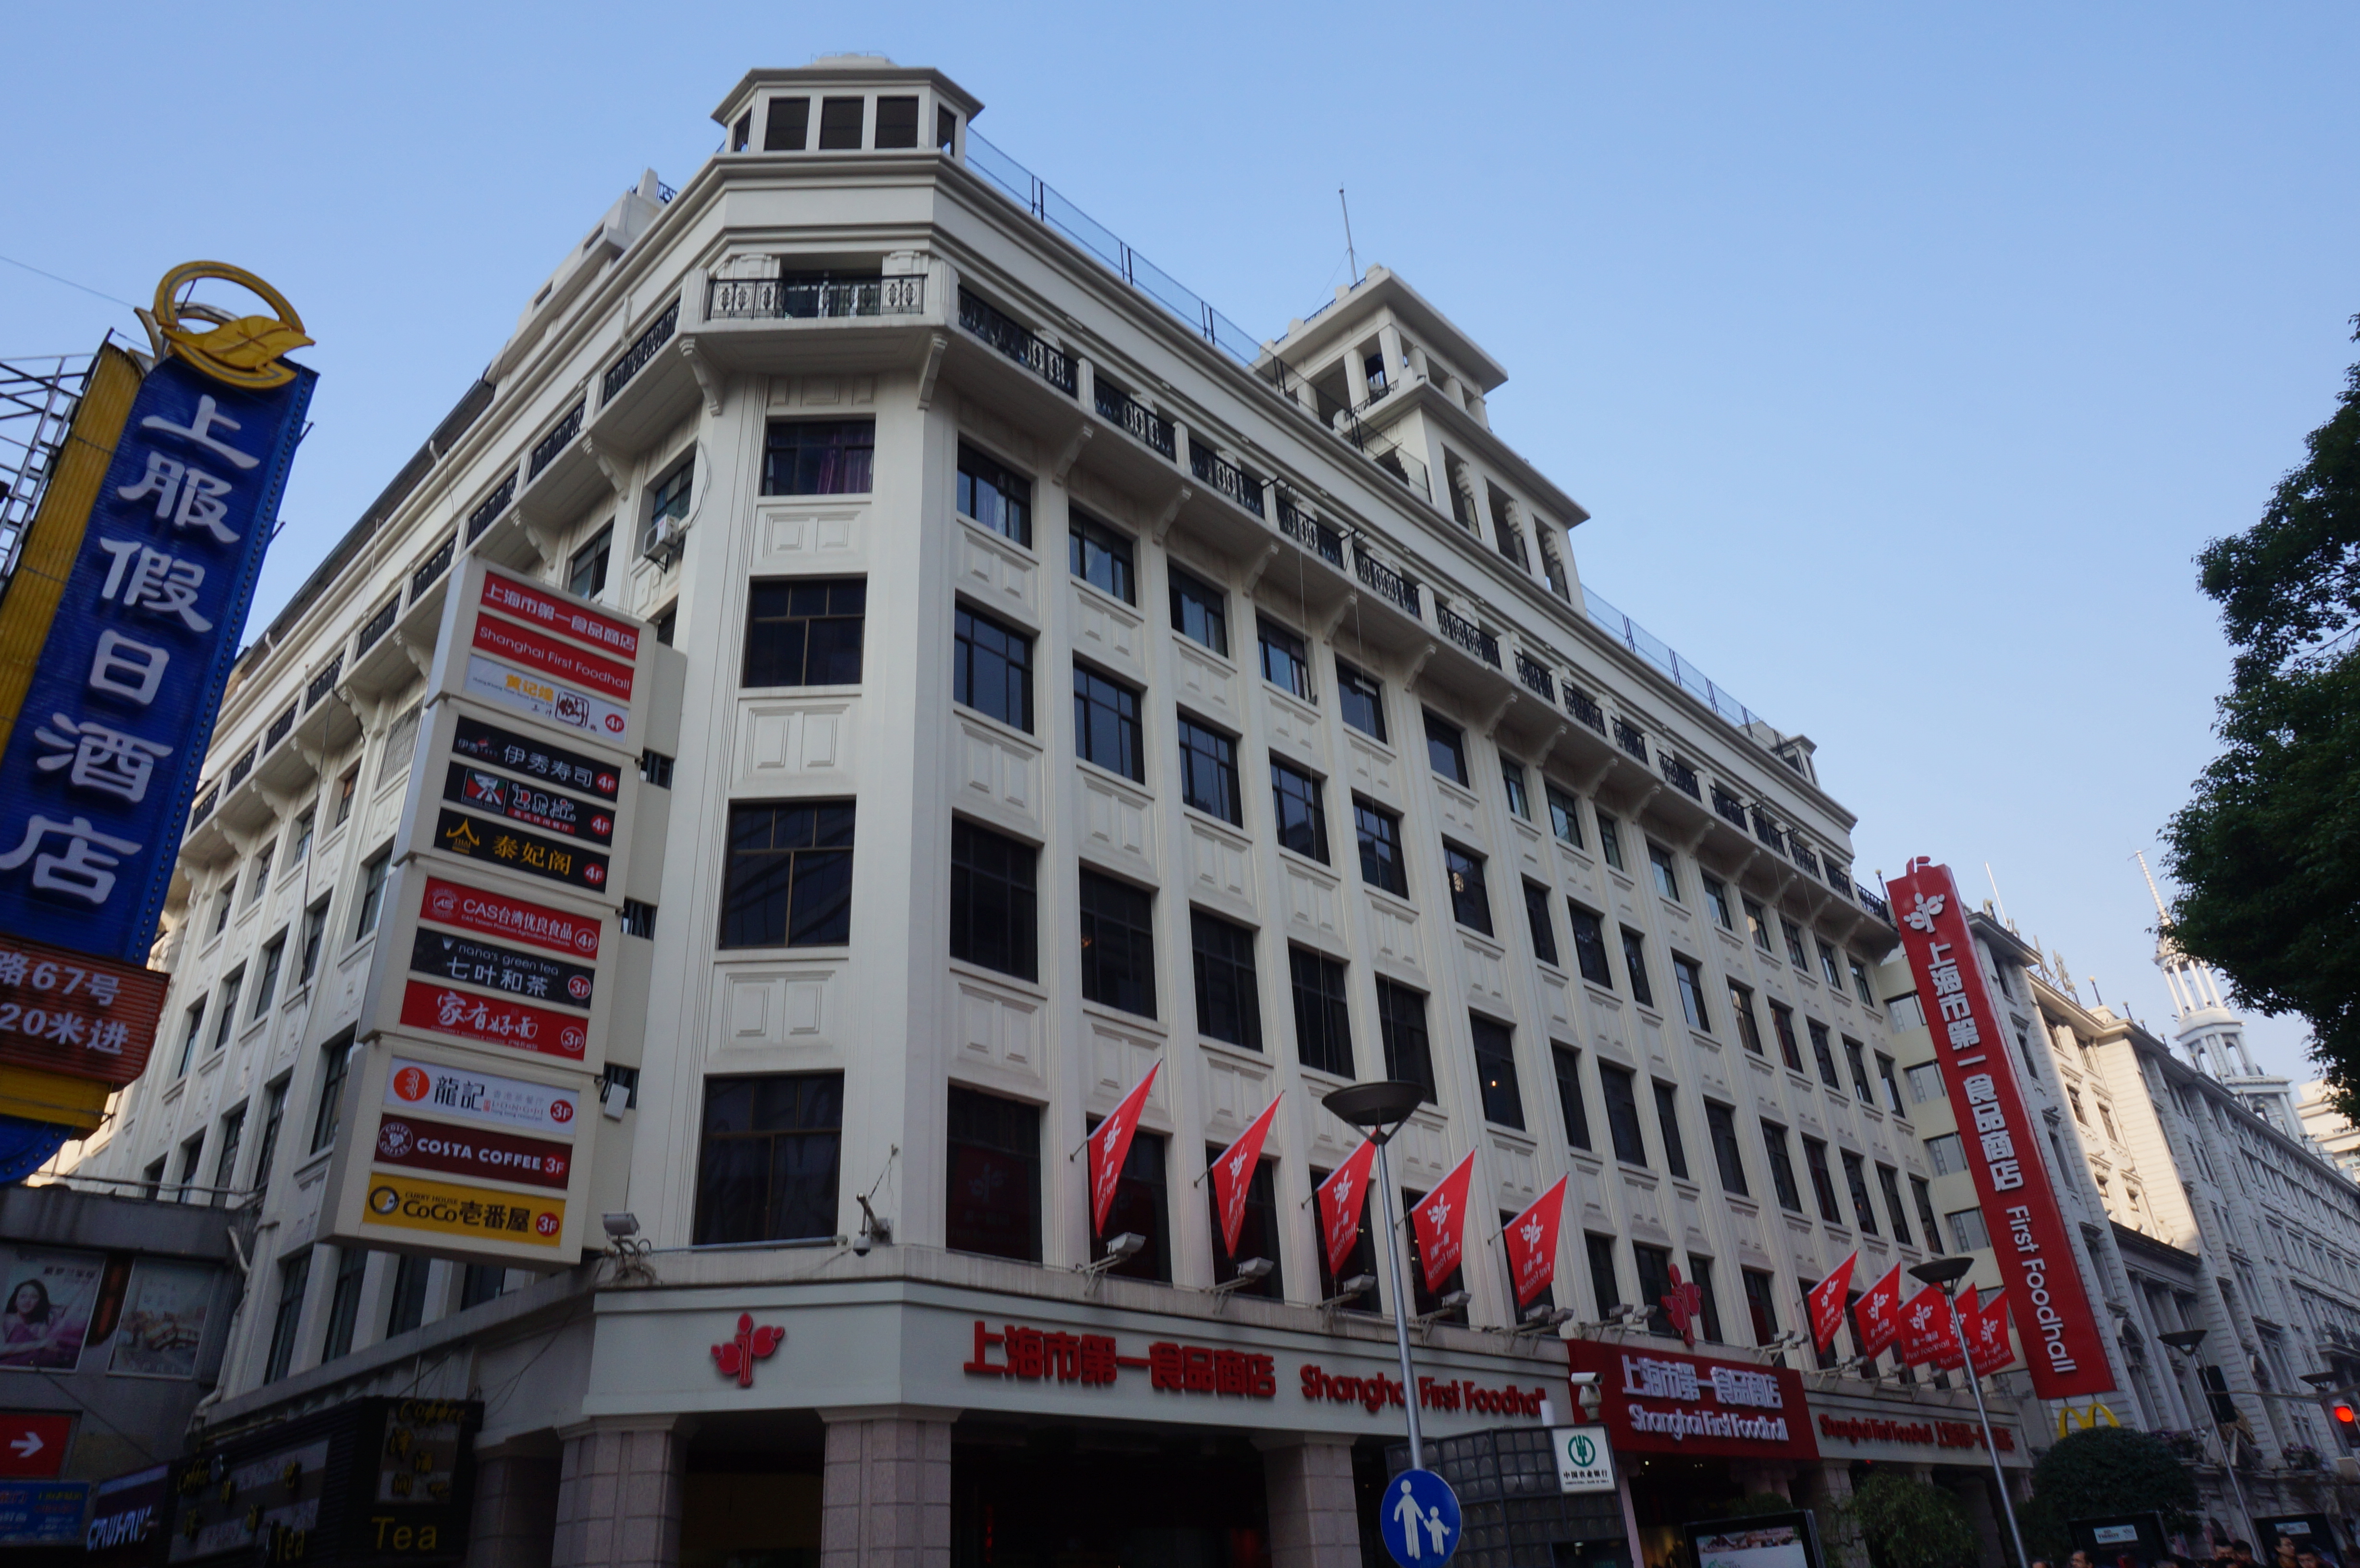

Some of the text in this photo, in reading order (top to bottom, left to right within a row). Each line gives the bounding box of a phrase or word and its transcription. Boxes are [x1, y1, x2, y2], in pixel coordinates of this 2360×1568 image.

[485, 583, 636, 652] 上海市第一食品商店
[0, 394, 260, 904] 上服假日酒店
[480, 626, 630, 691] Shanghai First Foodhall
[607, 715, 623, 731] 4F
[504, 744, 615, 790] 伊秀寿司 4F
[592, 818, 610, 833] 4F
[492, 835, 603, 881] 泰妃阁 4F
[459, 943, 559, 976] nana's green tea
[578, 933, 595, 948] 4F
[446, 956, 589, 998] 七叶和茶 3F
[437, 990, 538, 1040] 家有好面
[564, 1032, 582, 1046] 3F
[1927, 941, 2024, 1193] 上海市第一食品商店
[552, 1104, 572, 1119] 3F
[417, 1138, 565, 1174] COSTA COFFEE 3F
[538, 1216, 557, 1232] 3F
[2006, 1205, 2077, 1373] First Foodhall
[964, 1320, 1276, 1397] 上海市第一食品商店
[1418, 1376, 1461, 1409] First
[1622, 1354, 1783, 1409] 上海市第一食品商店
[1629, 1403, 1789, 1441] Shanghai First Foodhall
[370, 1516, 438, 1551] Tea
